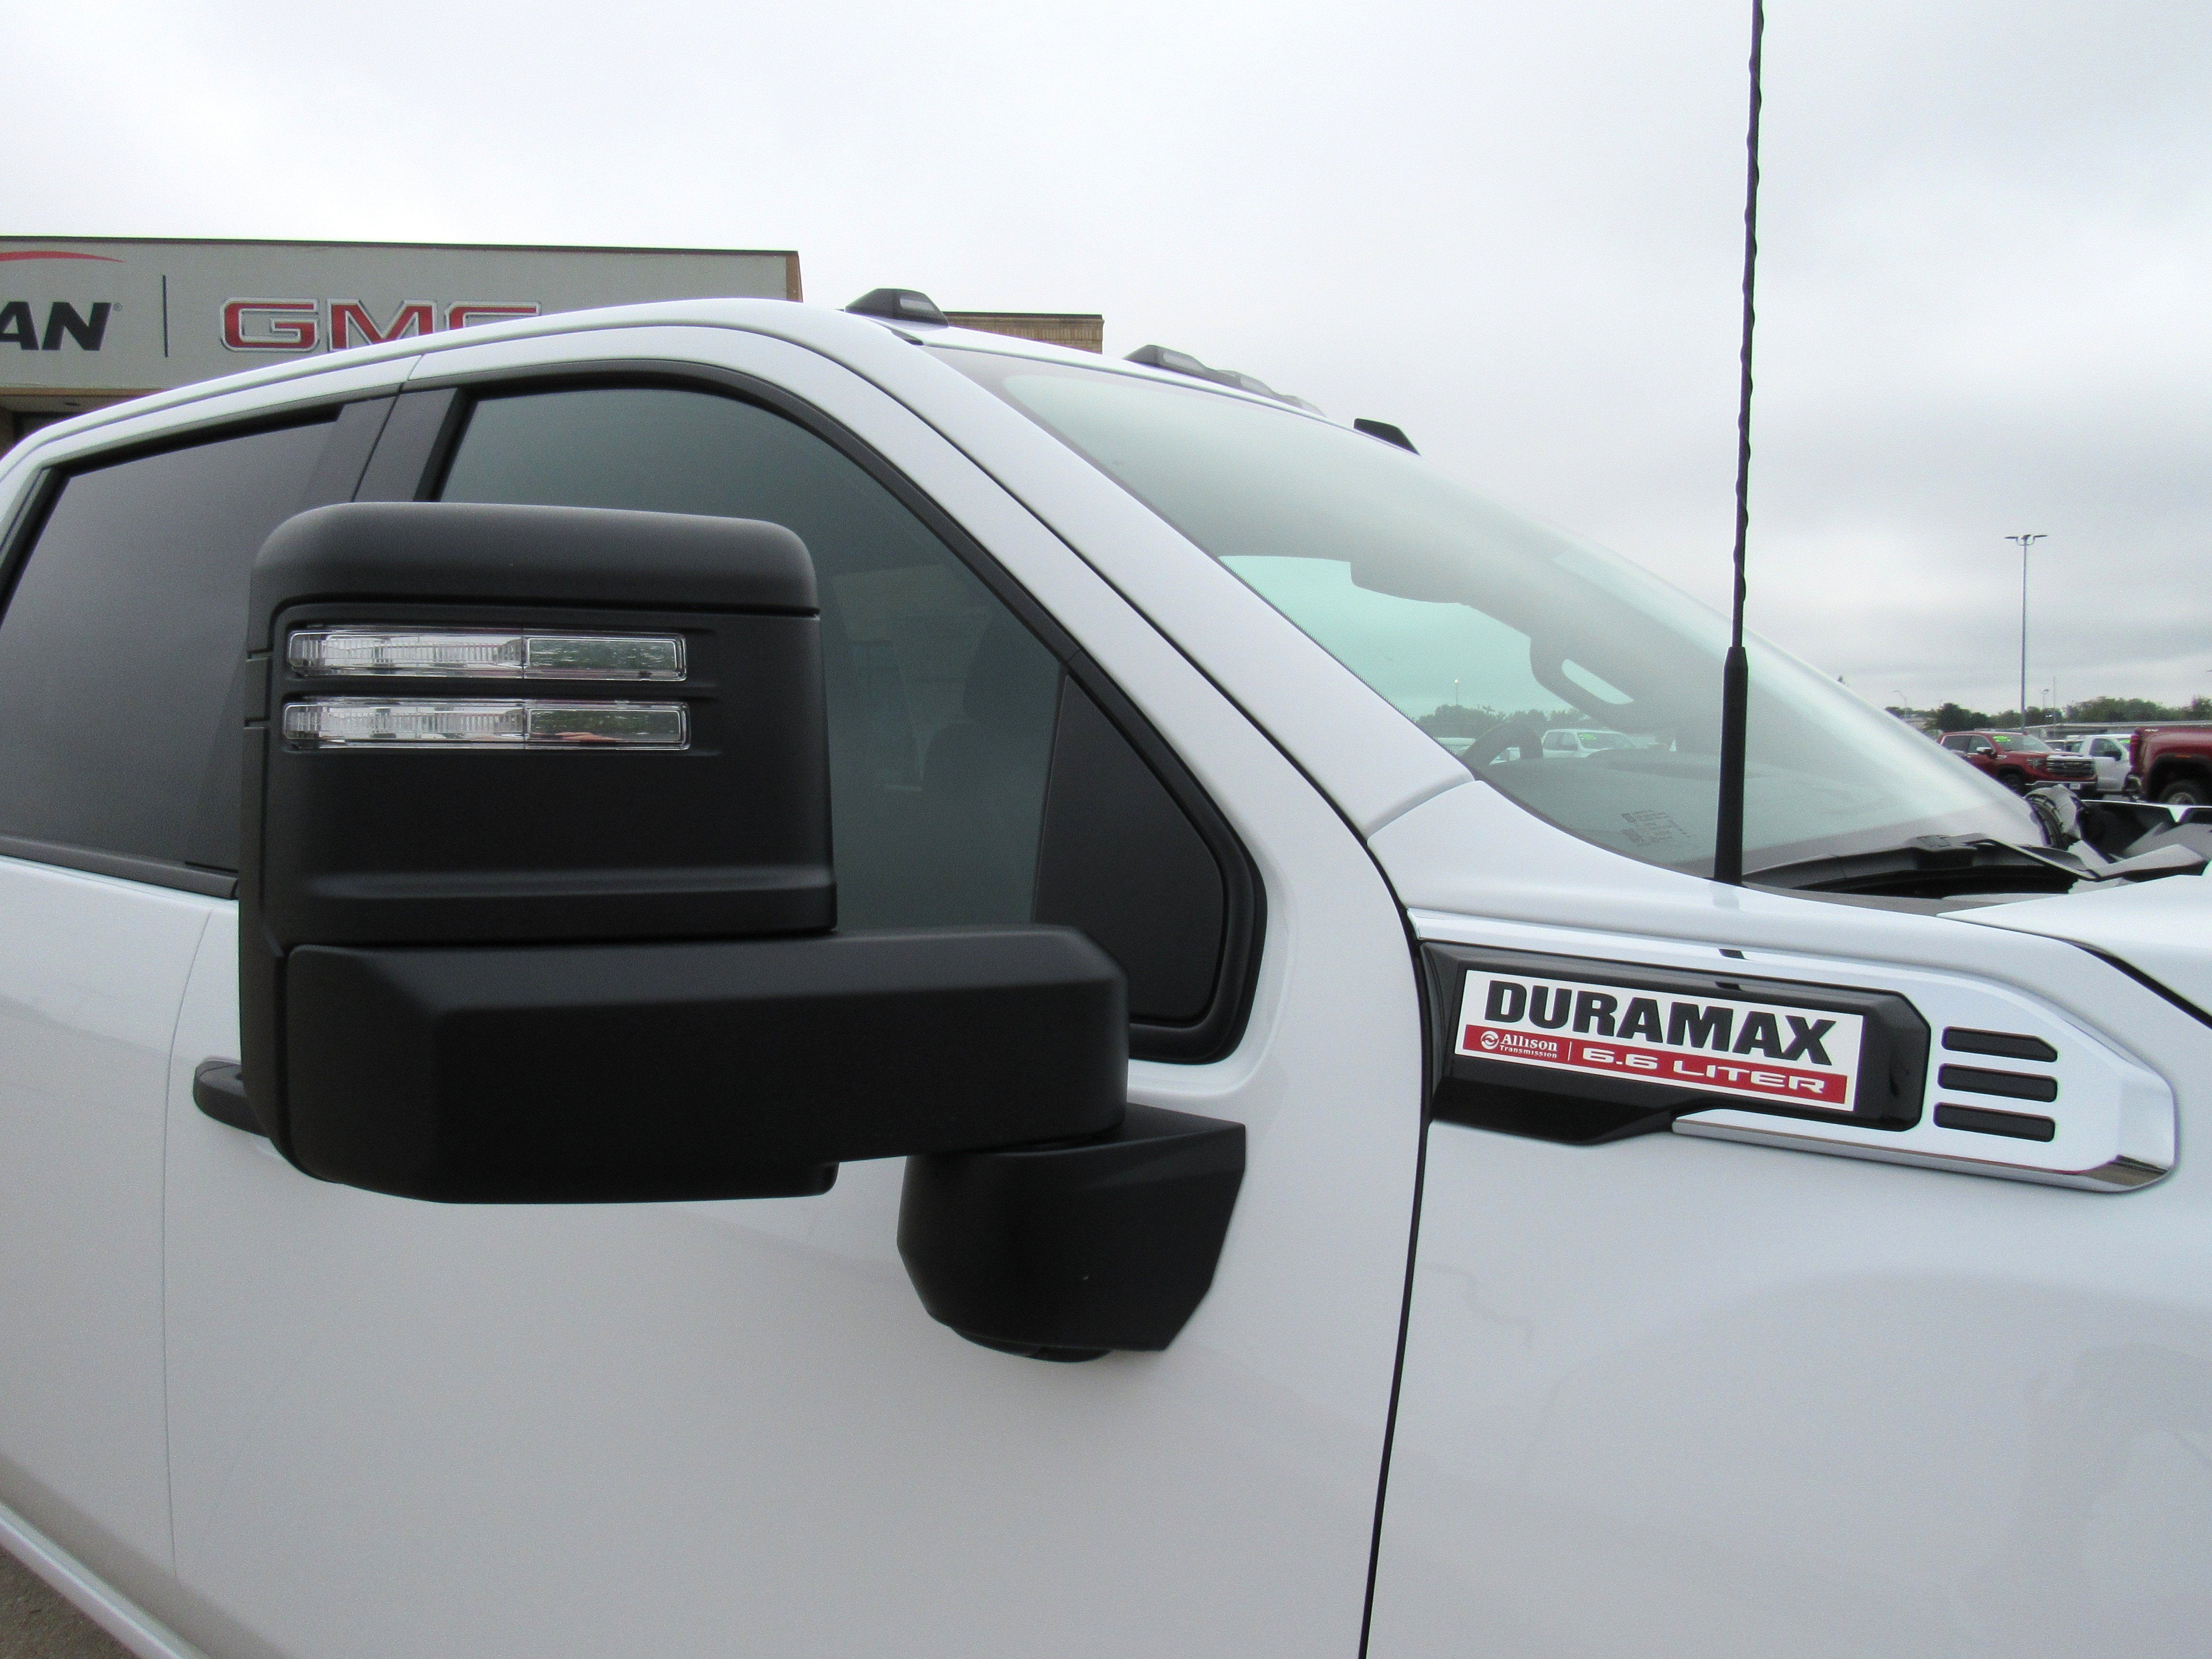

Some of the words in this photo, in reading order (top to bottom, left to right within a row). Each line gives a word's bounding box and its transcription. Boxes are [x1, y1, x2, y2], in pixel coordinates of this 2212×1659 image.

[1484, 980, 1837, 1066] DURAMAX
[1500, 1034, 1558, 1052] Allison
[1500, 1045, 1557, 1058] Transmission
[1583, 1047, 1658, 1070] 6.6
[1673, 1060, 1825, 1094] LITER
